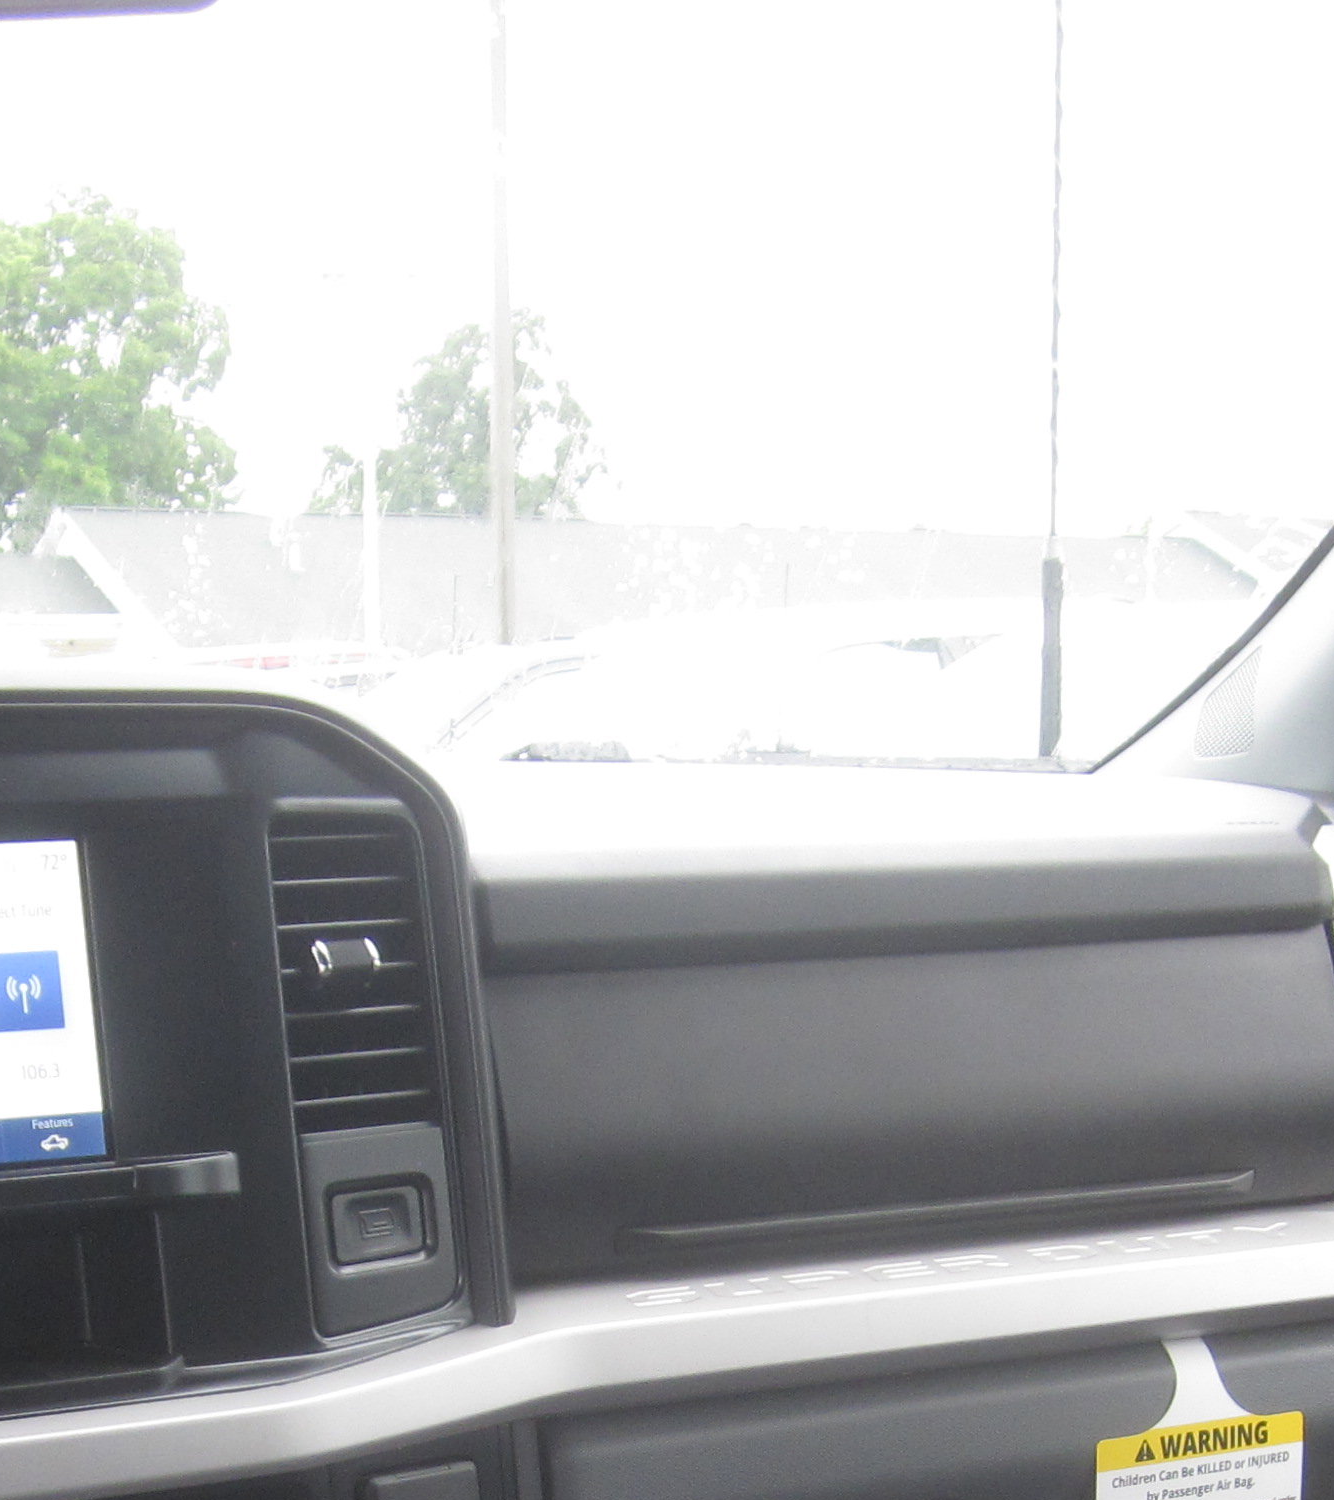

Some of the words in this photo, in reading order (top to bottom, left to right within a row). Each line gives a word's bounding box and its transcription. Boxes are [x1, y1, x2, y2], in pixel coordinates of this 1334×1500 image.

[21, 902, 53, 918] Tune
[22, 1062, 61, 1081] 106.3
[31, 1117, 74, 1131] Features
[624, 1253, 1011, 1308] SUPER
[1027, 1220, 1290, 1264] DUTY
[1160, 1421, 1268, 1459] WARNING
[1112, 1471, 1156, 1488] Children
[1158, 1468, 1179, 1482] Can
[1181, 1465, 1195, 1478] Be
[1197, 1460, 1232, 1475] KILLED
[1234, 1458, 1245, 1469] or
[1247, 1451, 1290, 1468] INJURED
[1162, 1482, 1214, 1500] Passenger
[1216, 1479, 1231, 1491] Air
[1234, 1476, 1255, 1490] Bag.
